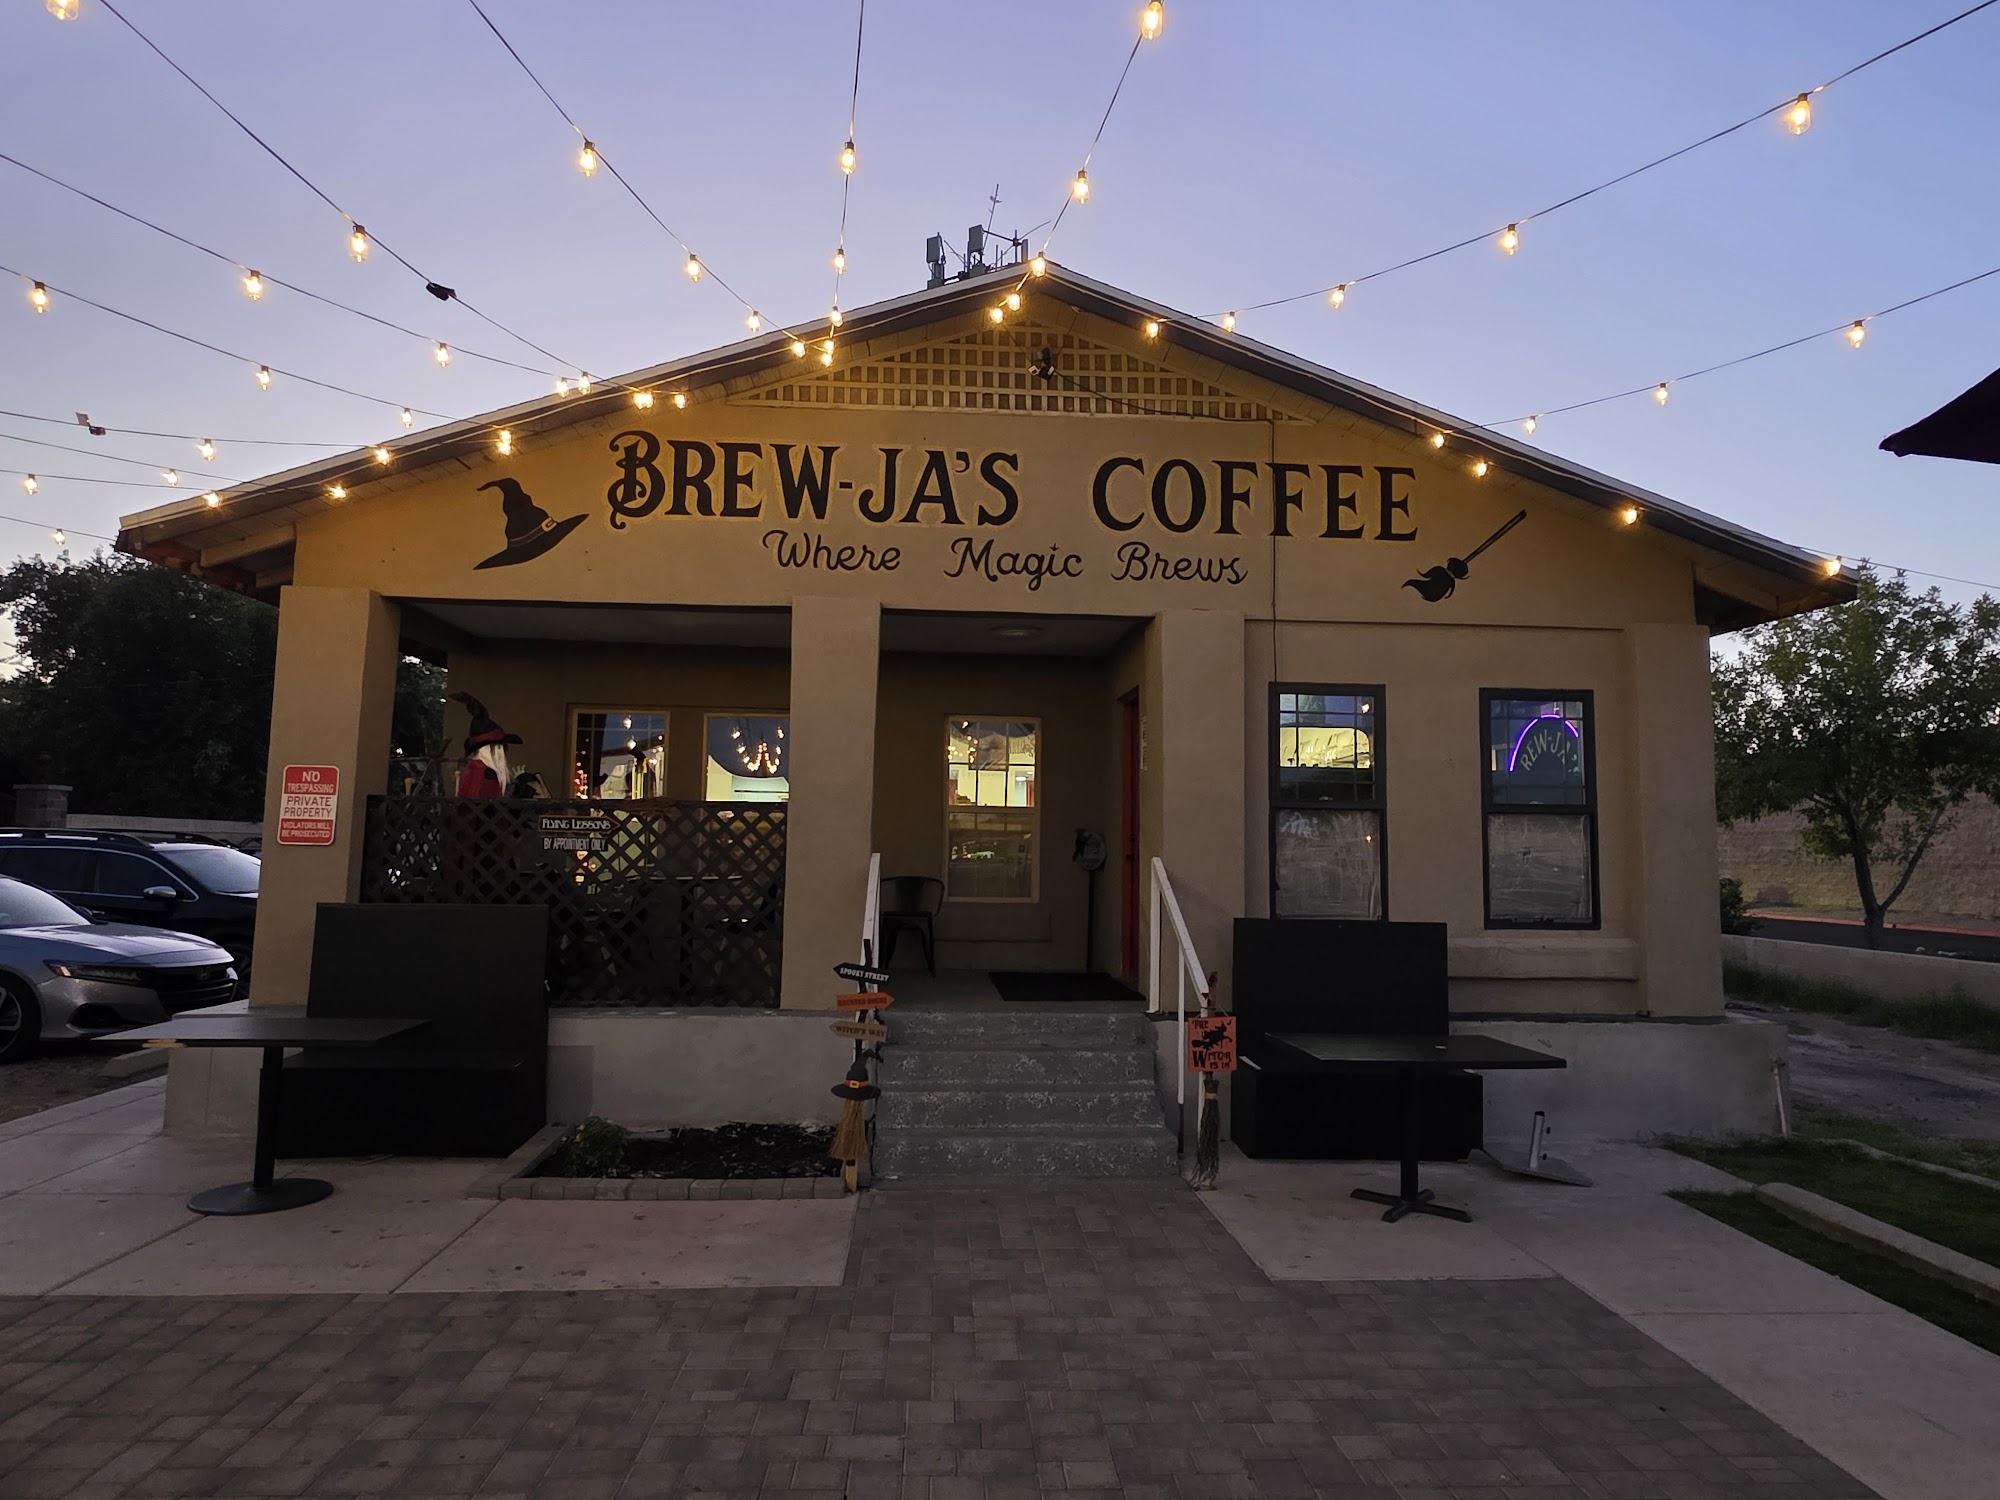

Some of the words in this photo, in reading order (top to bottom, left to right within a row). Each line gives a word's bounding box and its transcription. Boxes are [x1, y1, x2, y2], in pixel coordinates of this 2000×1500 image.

[607, 430, 1019, 529] BREW-JA'S
[1092, 457, 1419, 541] COFFEE
[762, 530, 900, 571] Where
[943, 536, 1084, 591] Magic
[1111, 541, 1248, 585] Brews
[302, 771, 320, 782] NO
[287, 783, 334, 793] TRESPASSING
[287, 796, 332, 807] PRIVATE
[284, 807, 332, 818] PROPERTY
[283, 822, 317, 830] VIOLATORS
[542, 818, 569, 829] FLYING
[572, 819, 611, 830] LESSONS
[282, 829, 290, 837] BE
[291, 830, 330, 838] PROSECUTED
[544, 838, 551, 850] BY
[553, 838, 590, 850] APPOINTMENT
[591, 839, 606, 850] ONLY
[840, 967, 864, 978] SPOOKY
[864, 971, 889, 982] STREET
[835, 1025, 866, 1035] WITCH'S
[868, 1028, 885, 1038] WAY
[1192, 1050, 1232, 1068] WITCH
[1209, 1062, 1219, 1070] IS
